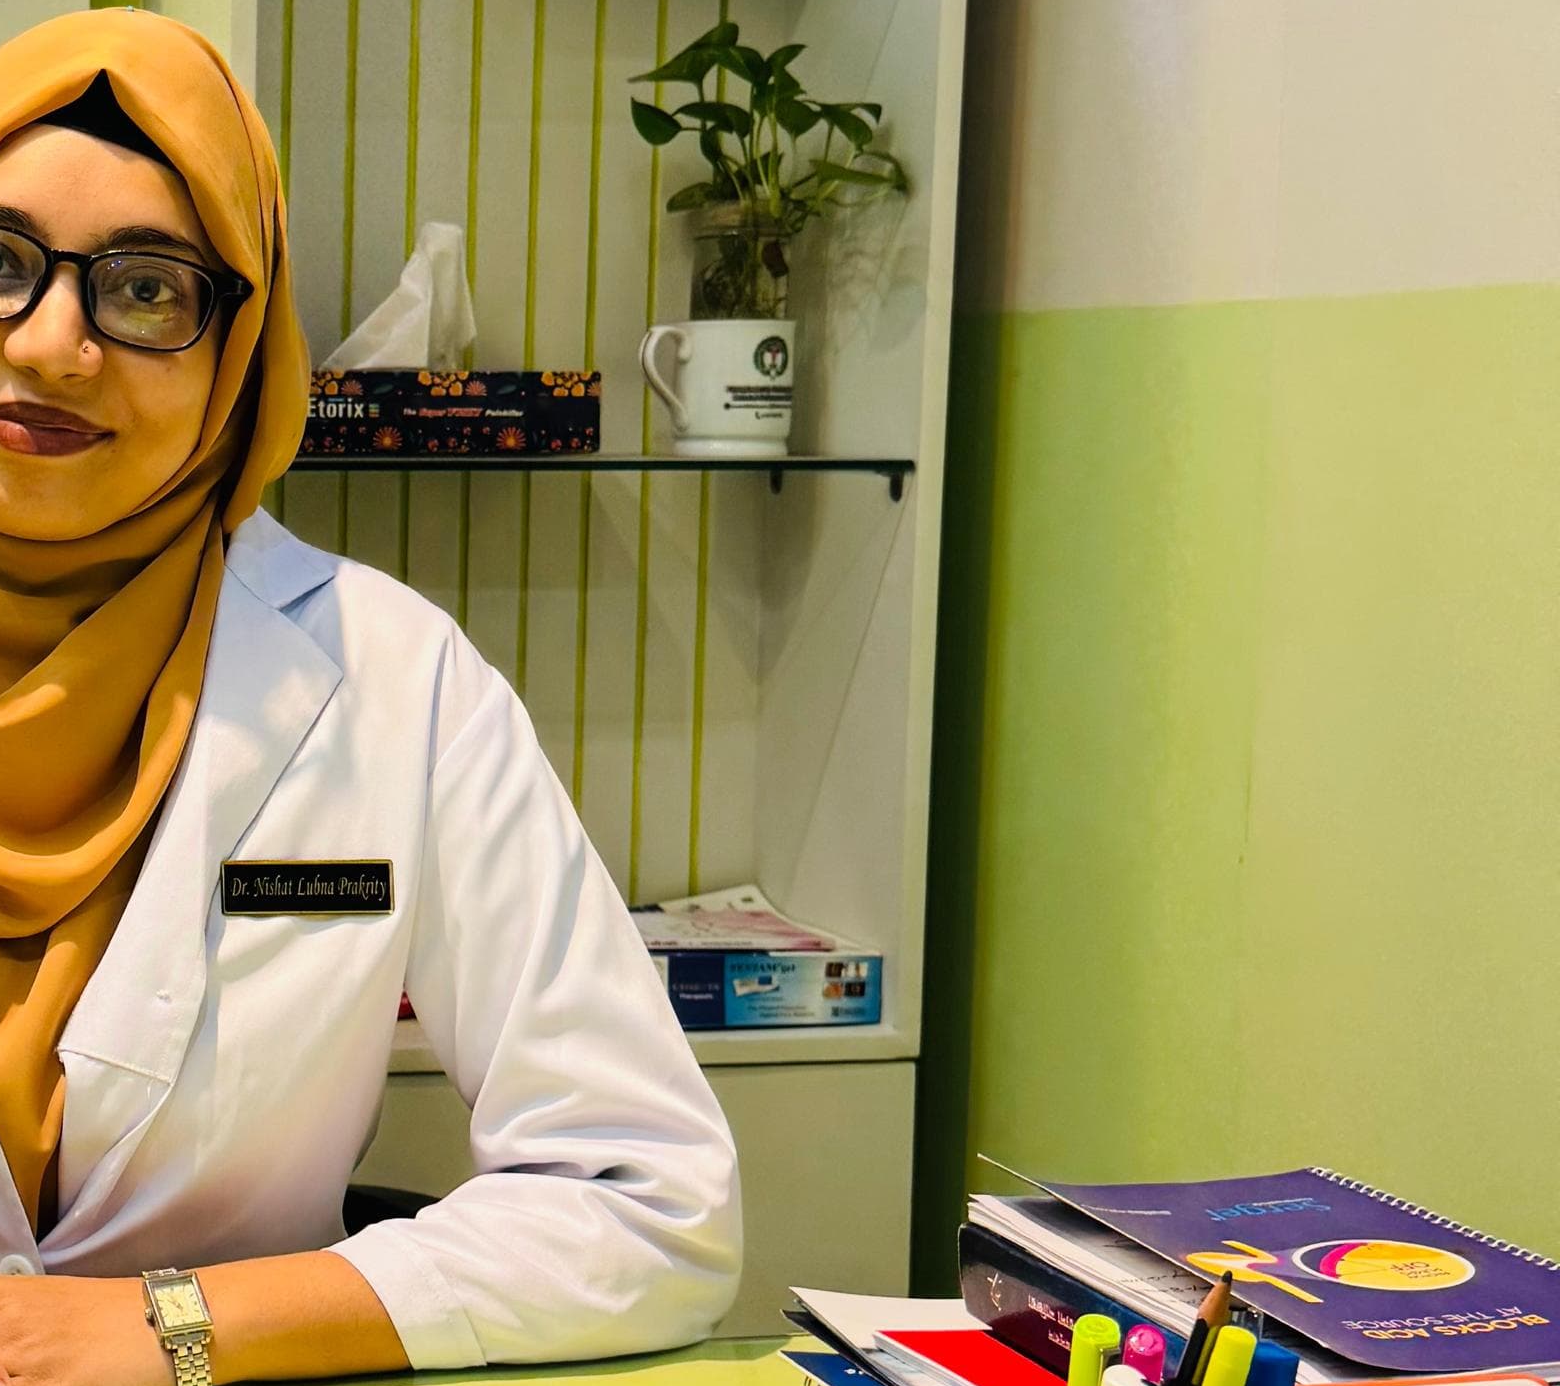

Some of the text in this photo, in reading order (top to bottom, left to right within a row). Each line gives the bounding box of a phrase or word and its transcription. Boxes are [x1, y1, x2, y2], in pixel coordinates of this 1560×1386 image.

[308, 397, 364, 419] Etorix
[232, 877, 250, 896] Dr.
[297, 874, 334, 896] Lubna
[338, 874, 387, 901] Prakrity
[1342, 1306, 1523, 1331] AT THE SOURCE
[1362, 1314, 1551, 1340] BLOCKS ACID
